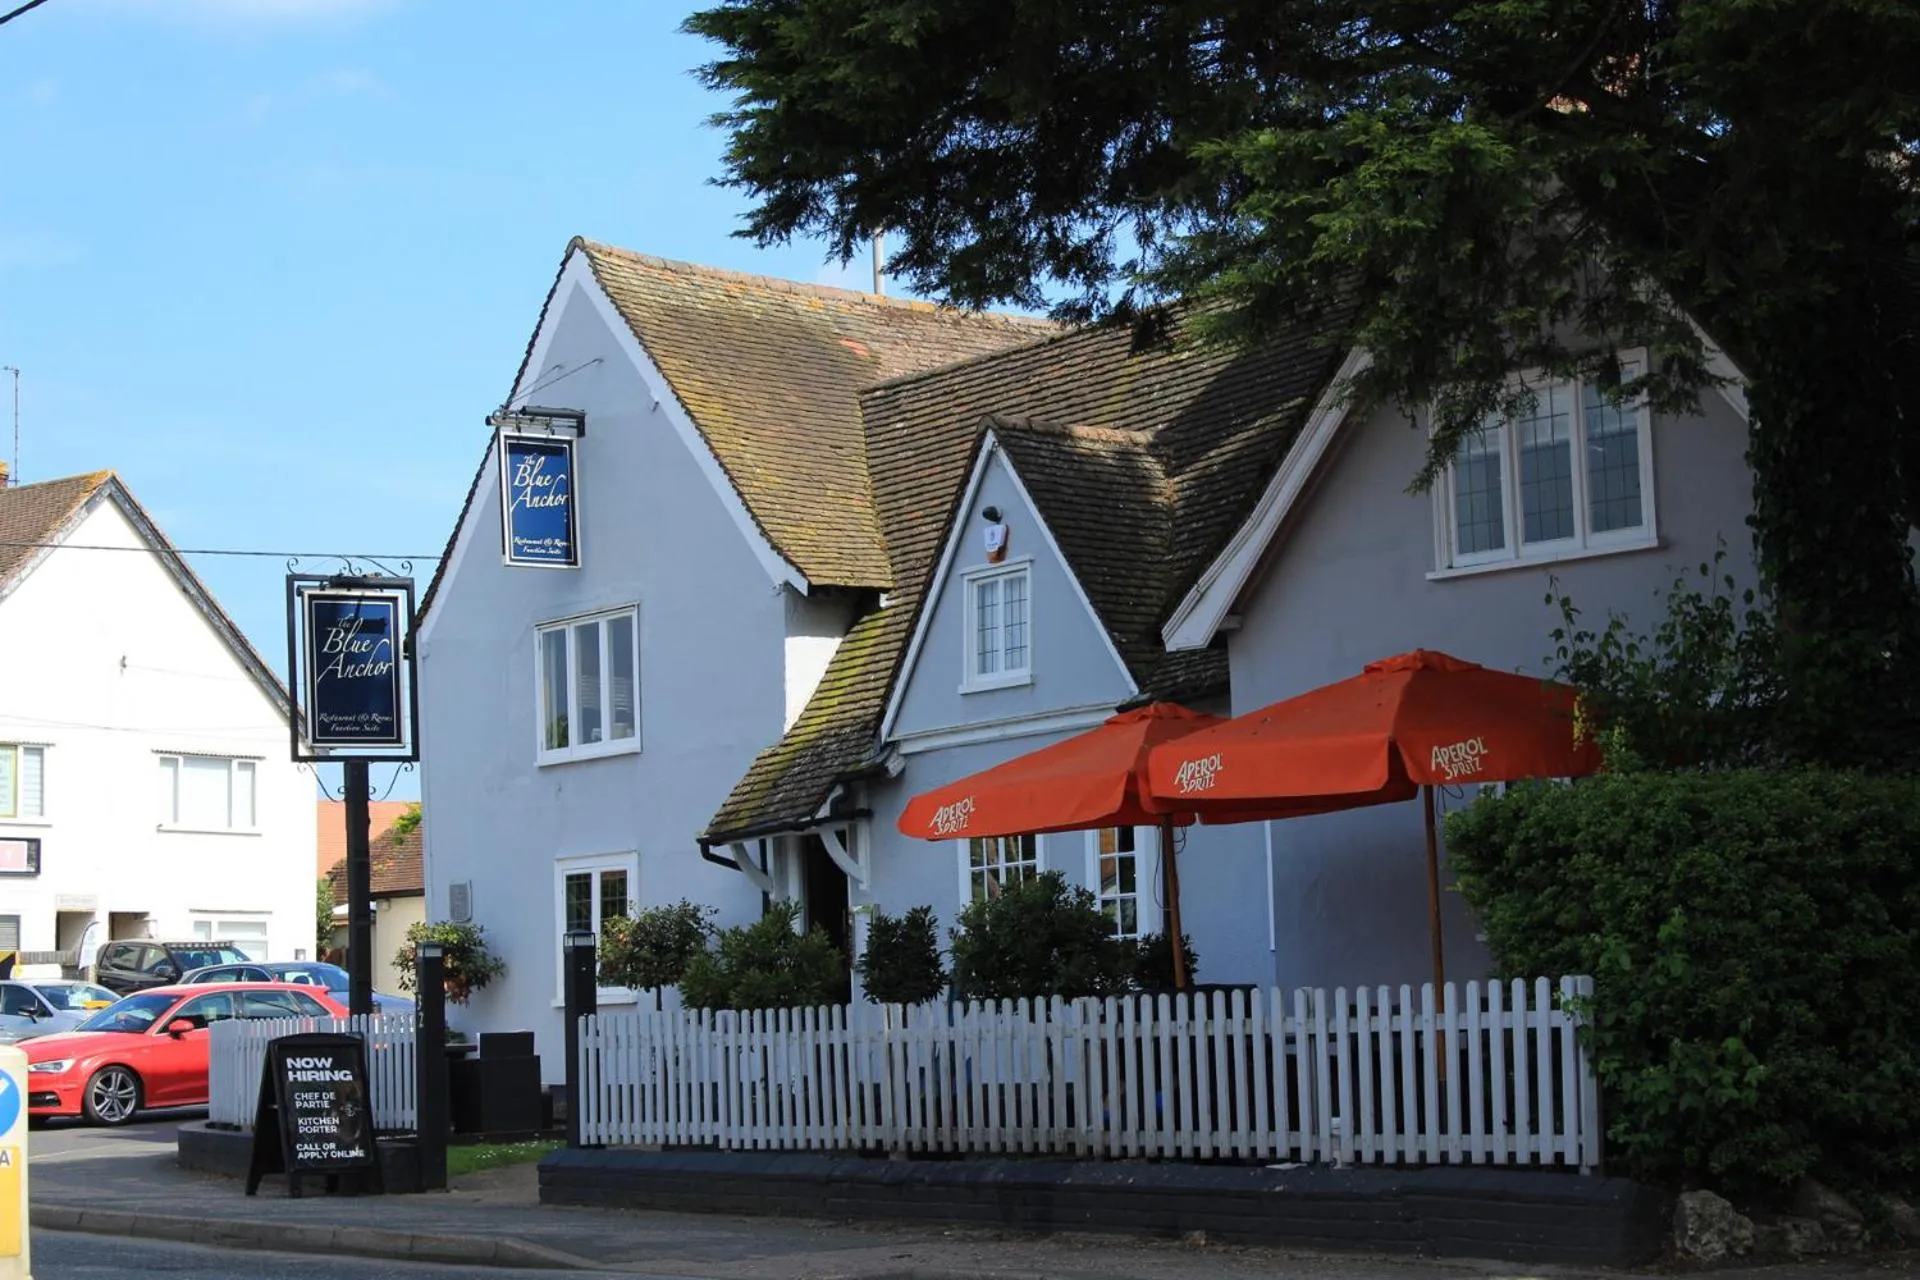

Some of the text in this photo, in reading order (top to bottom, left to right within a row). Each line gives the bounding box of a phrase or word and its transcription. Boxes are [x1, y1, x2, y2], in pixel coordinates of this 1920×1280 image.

[513, 455, 553, 487] Blue
[510, 474, 569, 513] Anchor
[322, 617, 374, 654] Blue
[317, 638, 393, 683] Anchor
[1431, 736, 1488, 772] APEROL
[1174, 753, 1223, 785] APEROL
[1444, 757, 1483, 780] SPRITZ
[1180, 773, 1215, 793] SPRITZ
[928, 796, 976, 828] APEROL
[286, 1057, 333, 1069] NOW
[287, 1070, 353, 1082] HIRING
[294, 1091, 336, 1100] CHEF DE
[295, 1100, 331, 1109] PARTIE
[297, 1117, 340, 1126] KITCHEN
[298, 1125, 338, 1134] PORTER
[296, 1143, 321, 1151] CALL
[297, 1149, 365, 1160] APPLY ONLINE
